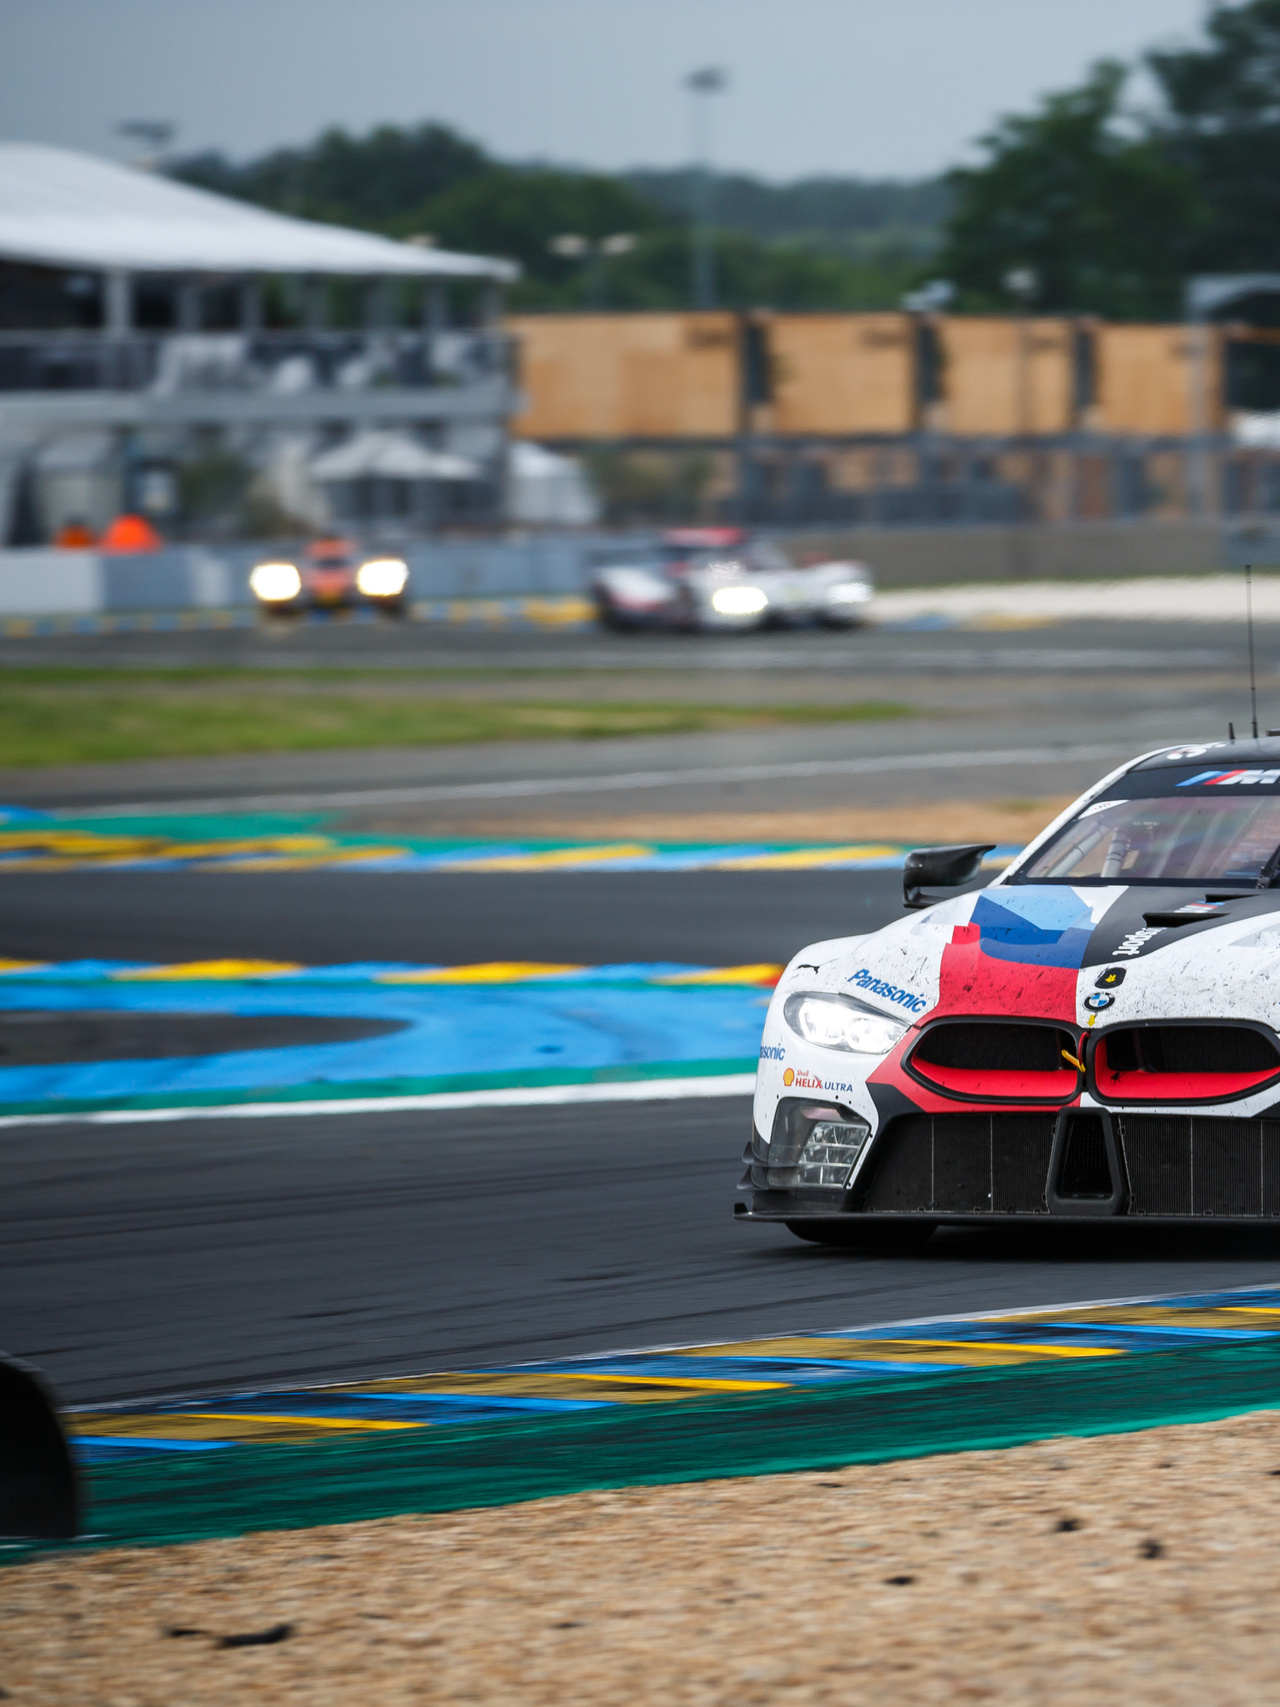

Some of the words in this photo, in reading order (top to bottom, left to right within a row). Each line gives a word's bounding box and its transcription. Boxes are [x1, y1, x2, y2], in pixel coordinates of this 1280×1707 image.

[847, 968, 927, 1013] Panasonic
[795, 1075, 823, 1089] HELIX
[824, 1081, 853, 1092] ULTRA
